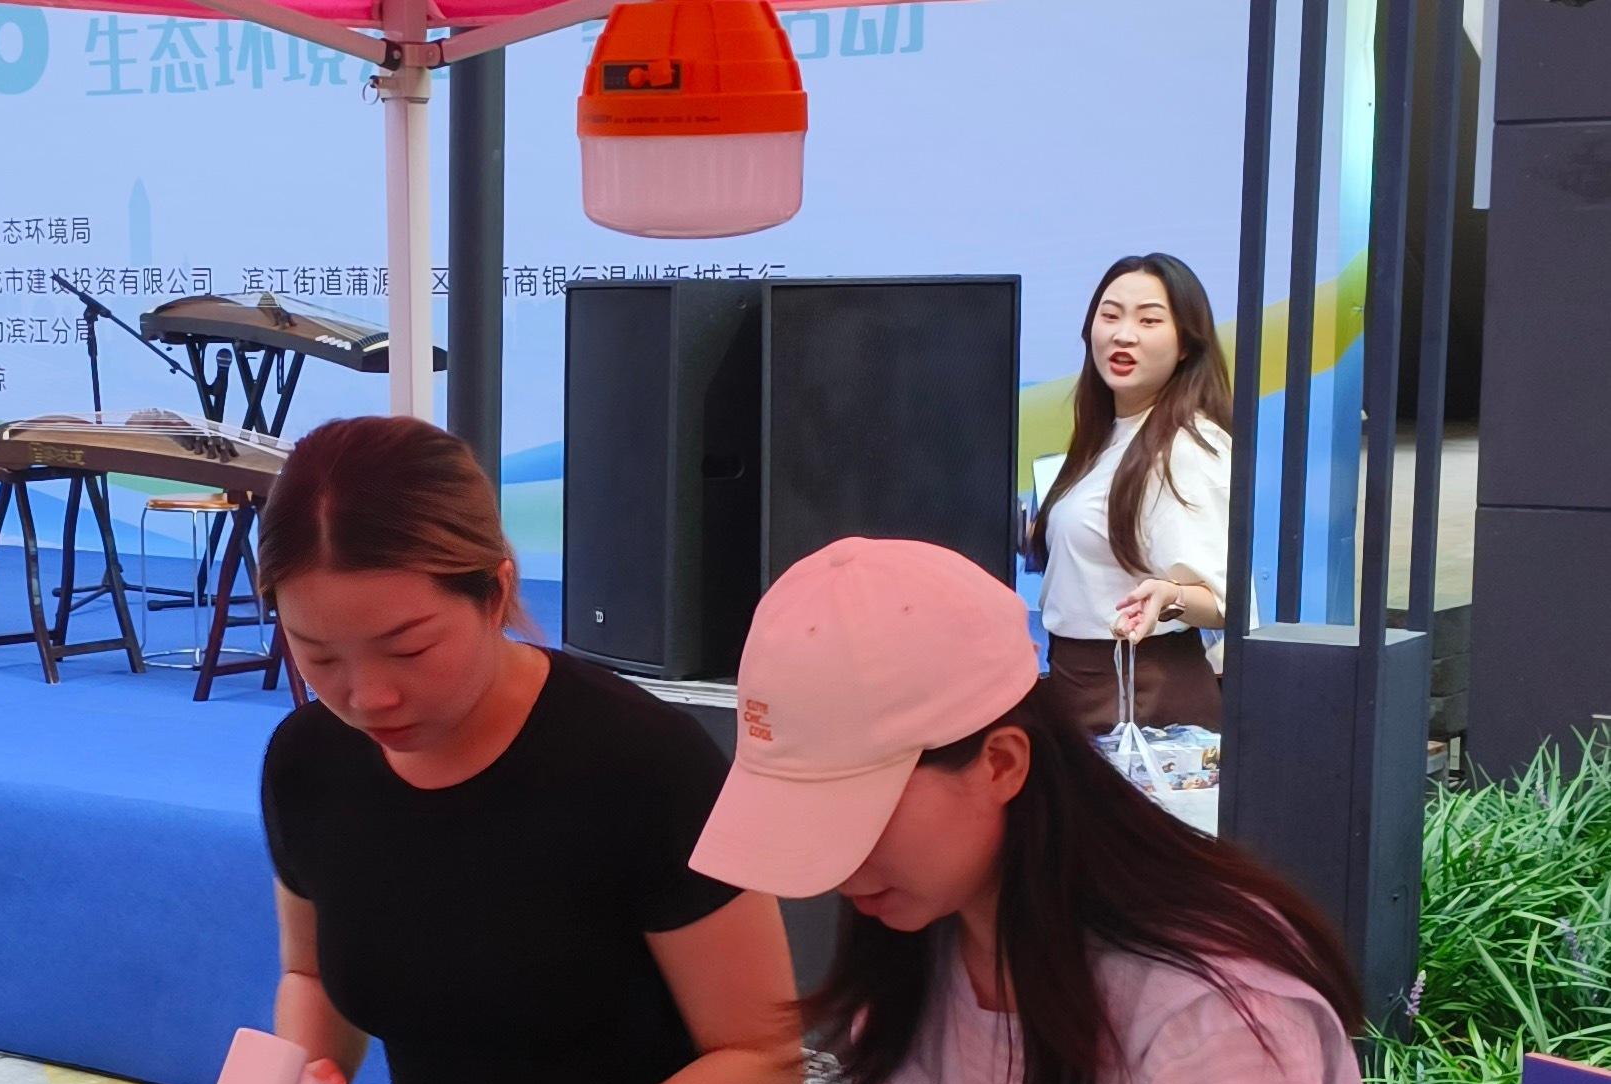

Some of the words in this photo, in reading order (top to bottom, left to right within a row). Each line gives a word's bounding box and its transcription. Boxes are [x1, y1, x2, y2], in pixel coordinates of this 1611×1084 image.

[241, 265, 449, 296] 滨江街道蒲源区
